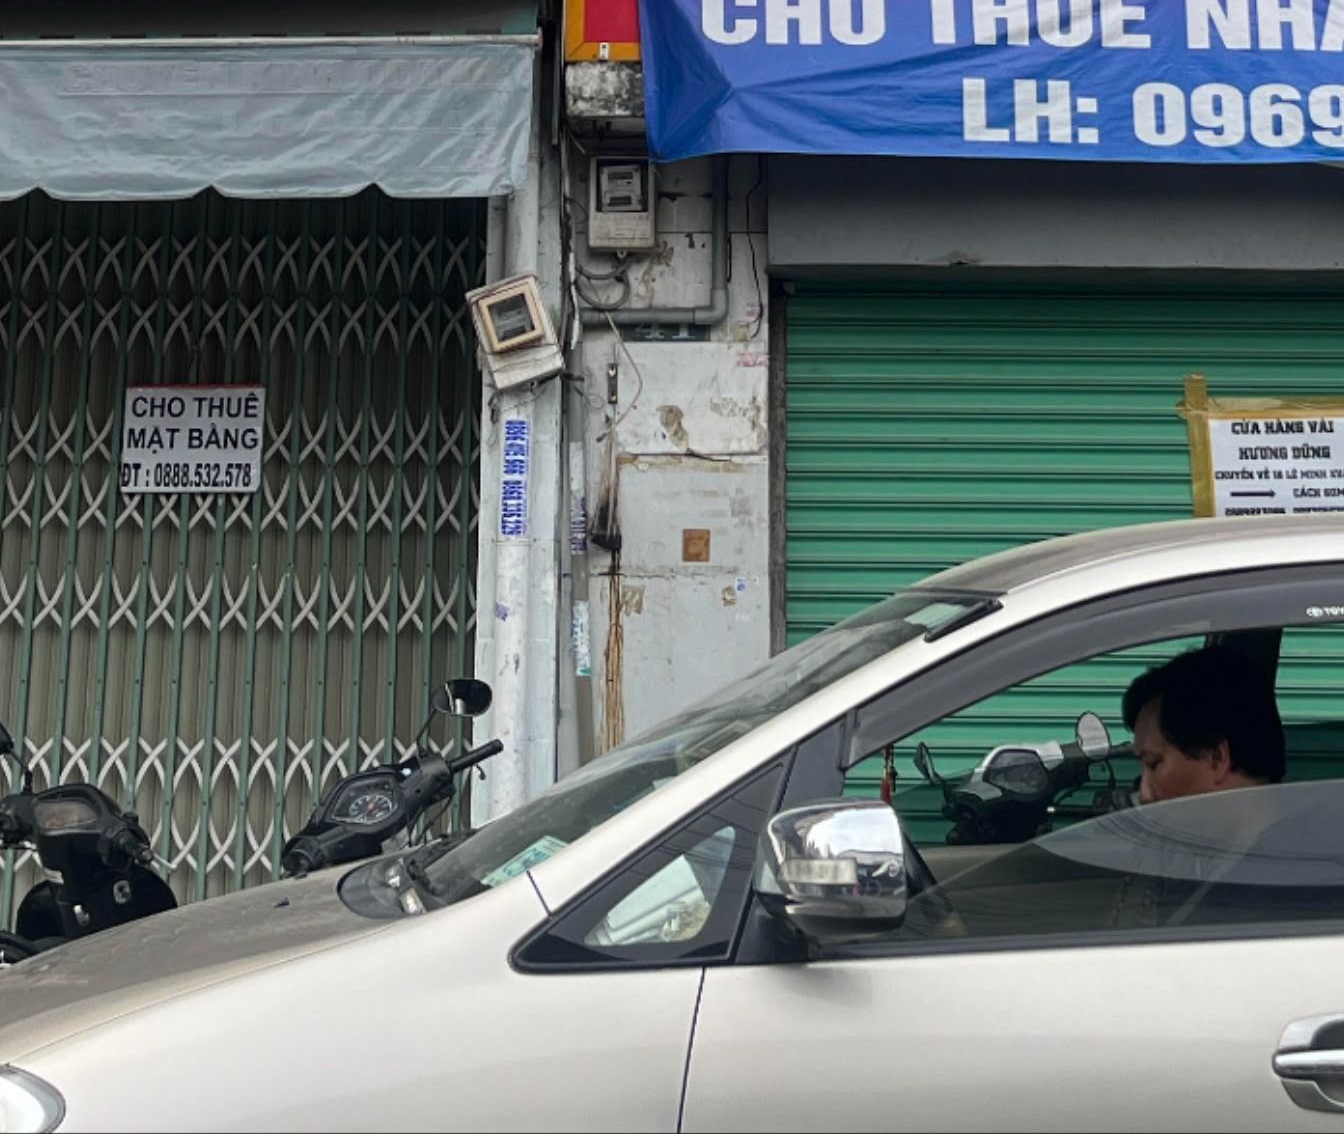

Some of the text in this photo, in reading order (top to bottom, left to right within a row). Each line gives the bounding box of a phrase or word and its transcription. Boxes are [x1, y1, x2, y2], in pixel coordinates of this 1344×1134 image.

[962, 77, 1101, 144] LH:
[131, 392, 260, 418] CHO THUÊ
[154, 463, 252, 488] 0888.532.578
